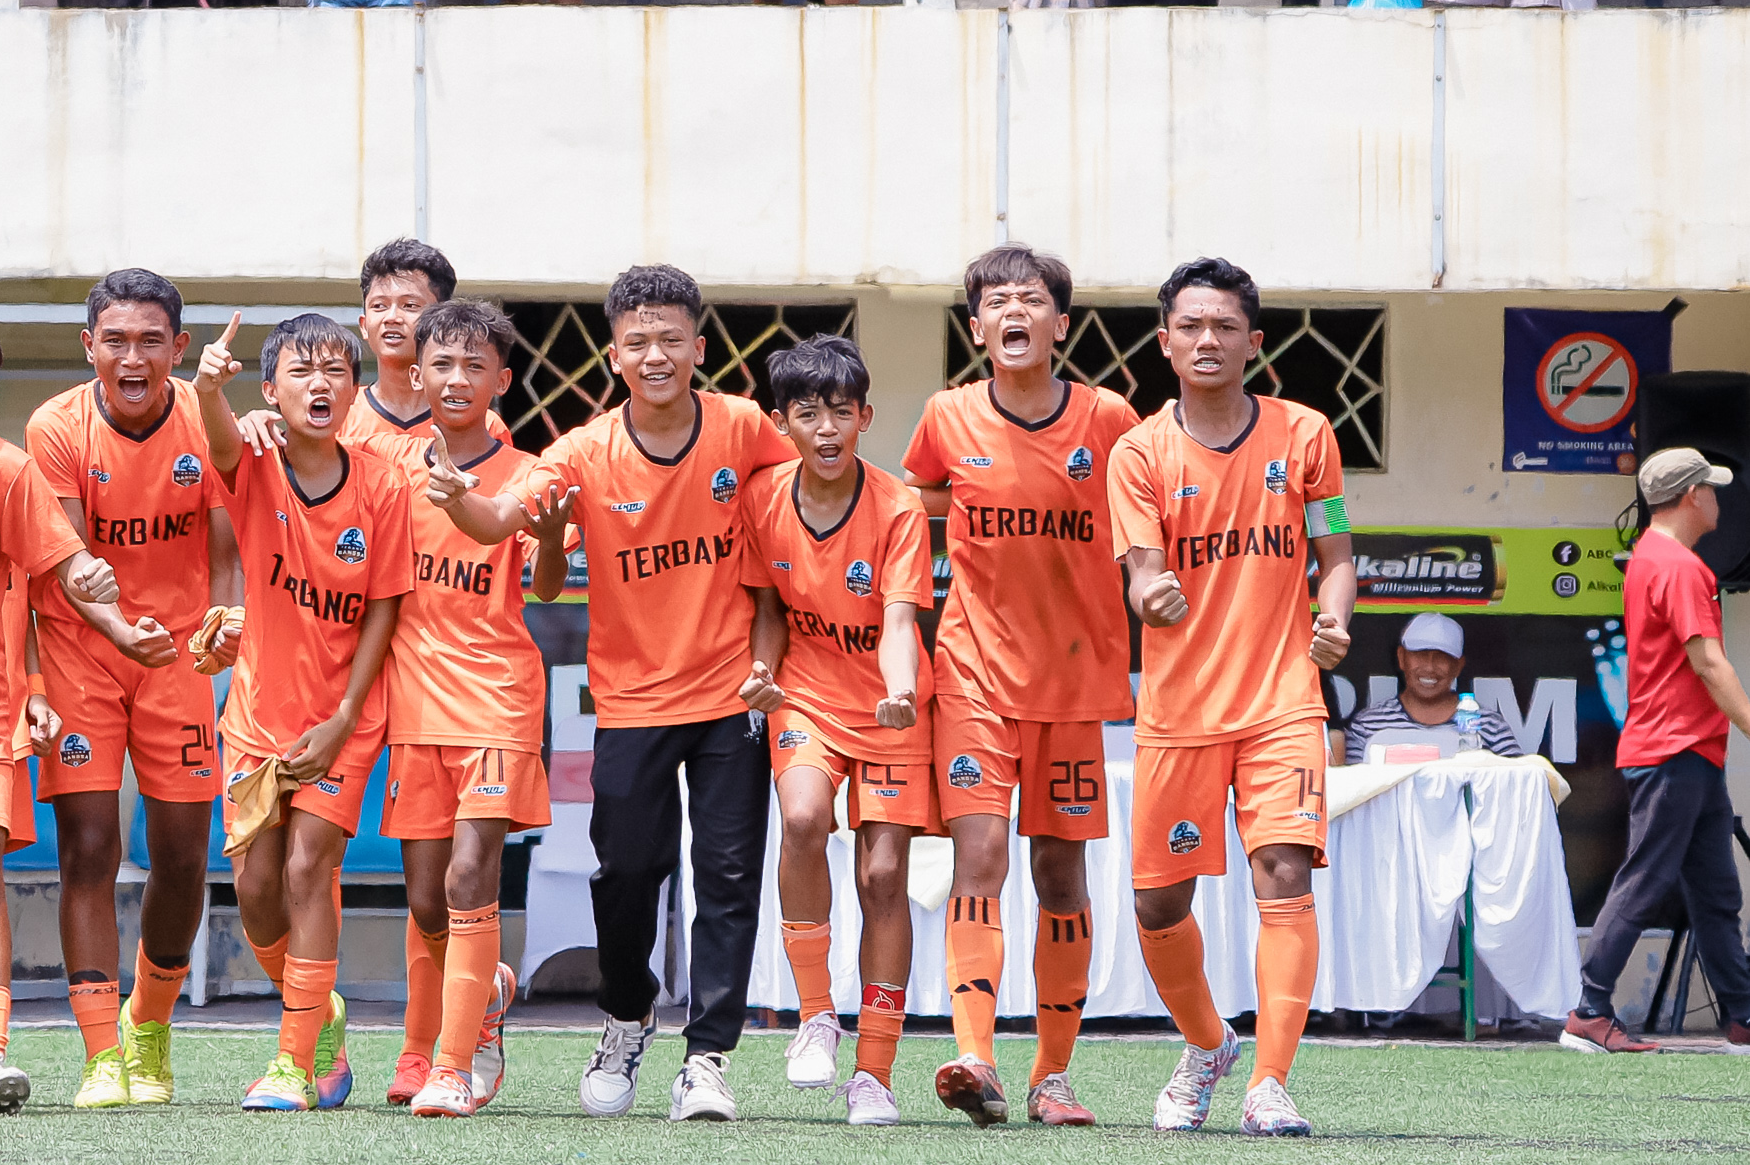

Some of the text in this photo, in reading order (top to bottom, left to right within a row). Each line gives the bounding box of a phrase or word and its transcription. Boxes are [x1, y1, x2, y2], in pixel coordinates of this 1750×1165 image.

[1557, 441, 1604, 450] SMOKING
[1607, 442, 1634, 451] AREA
[966, 505, 1094, 544] TERBANG
[1177, 524, 1295, 571] TERBANG
[1587, 549, 1613, 559] ABC
[1445, 583, 1485, 593] Power
[1587, 580, 1624, 592] Alkal
[181, 724, 214, 767] 24
[1049, 760, 1098, 803] 26
[1292, 768, 1325, 811] 14
